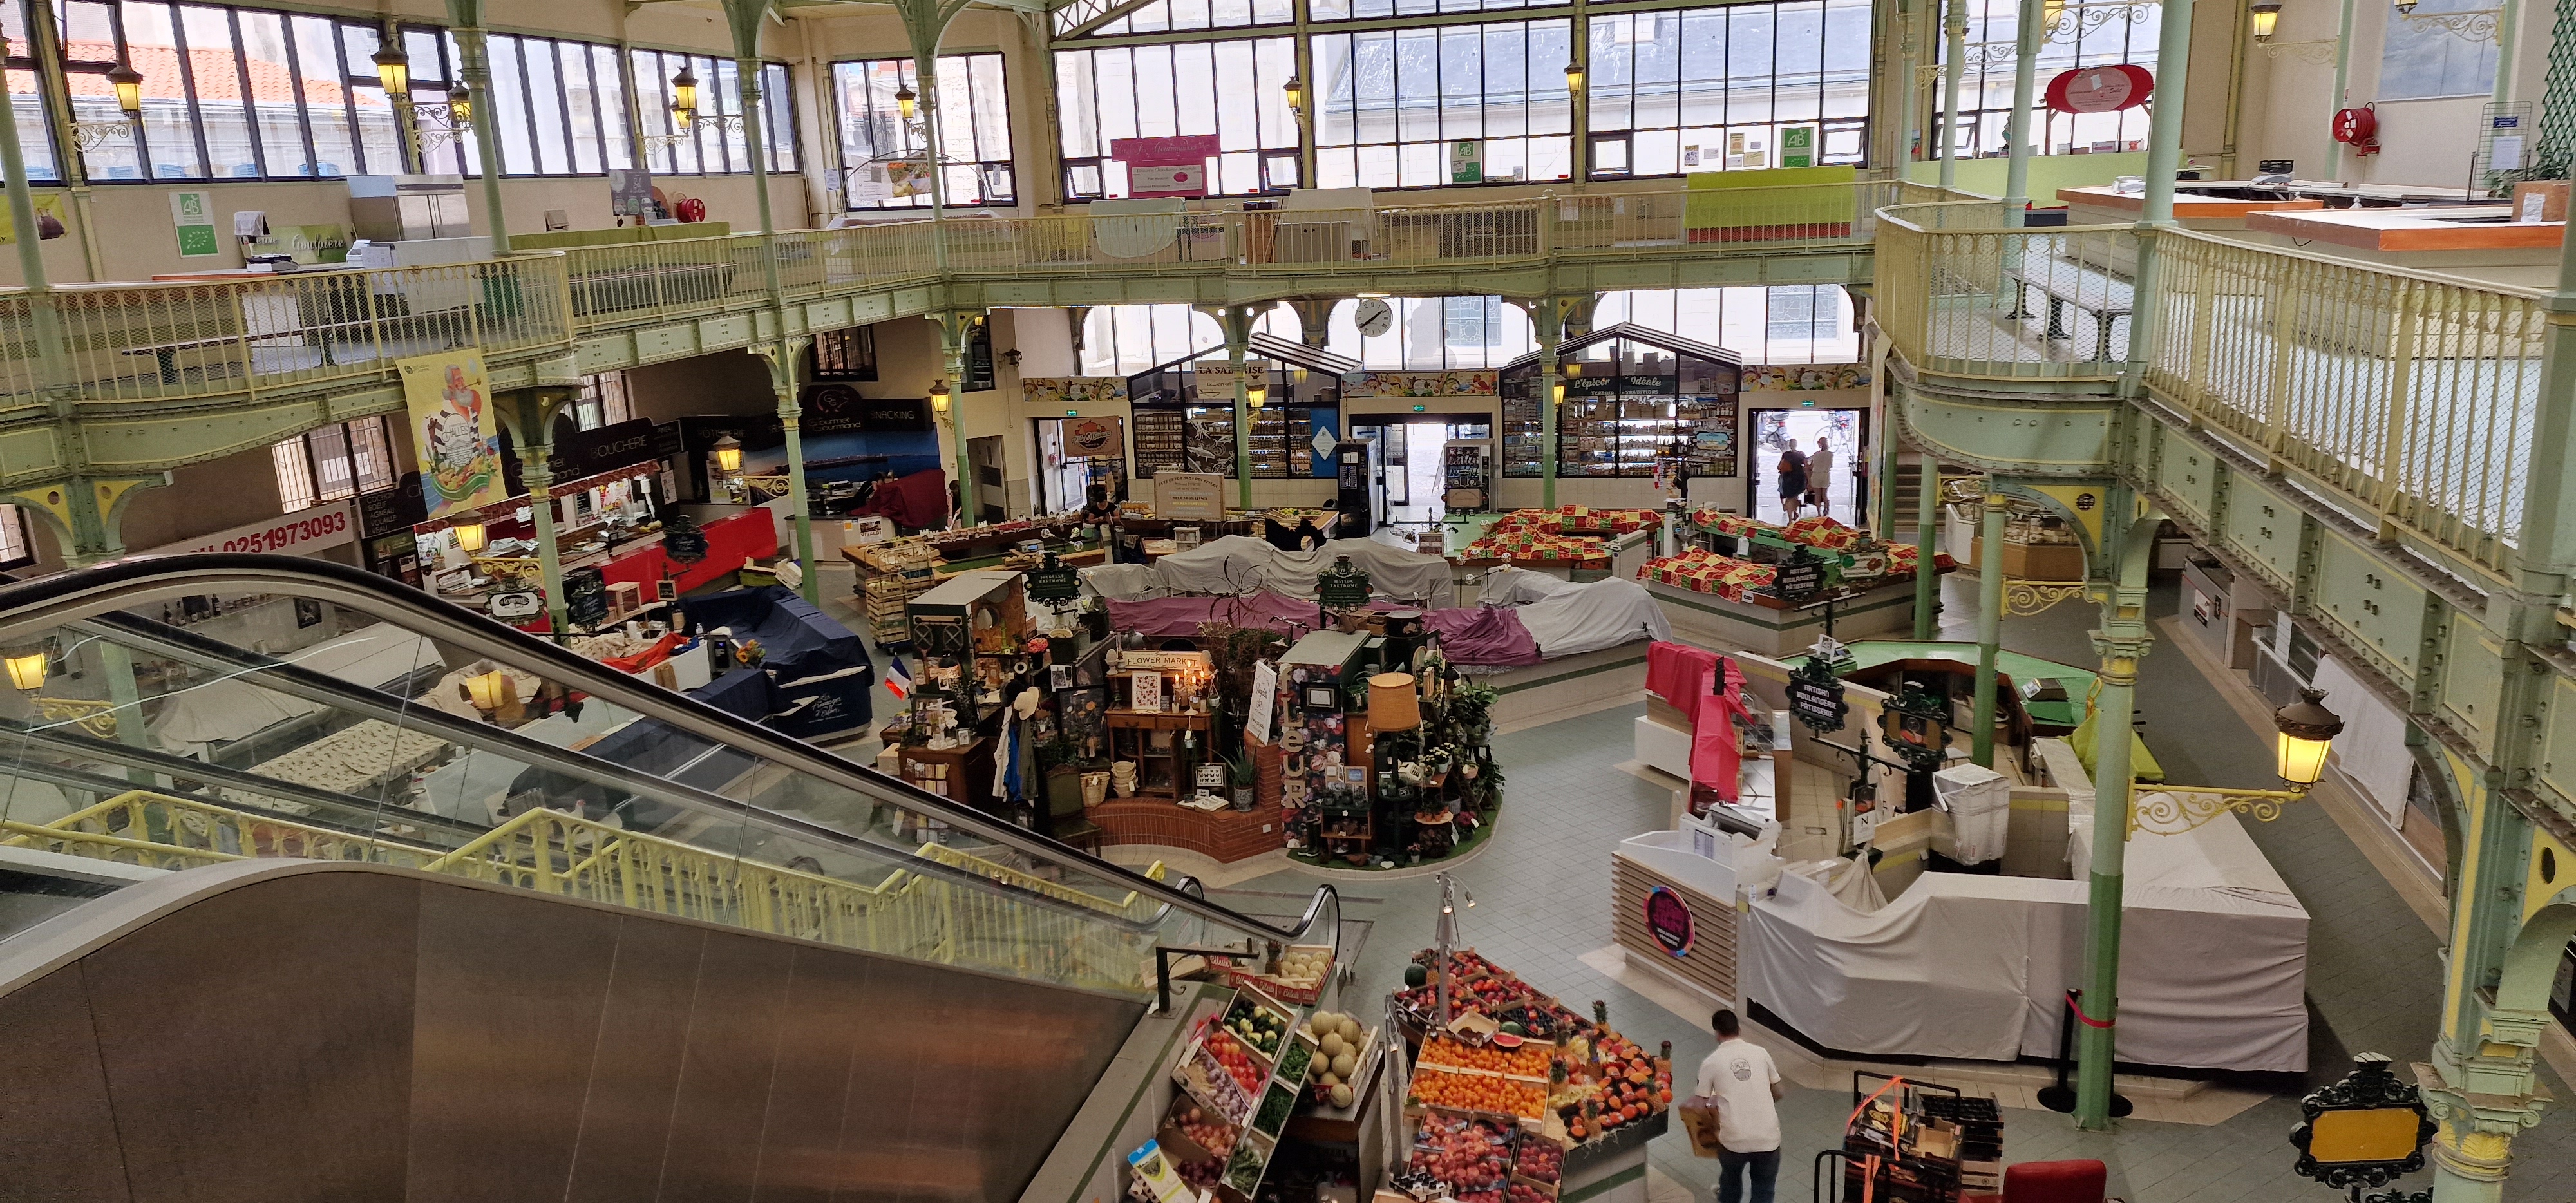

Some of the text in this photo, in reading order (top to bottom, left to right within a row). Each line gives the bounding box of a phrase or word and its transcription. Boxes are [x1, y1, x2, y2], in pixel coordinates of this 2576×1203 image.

[590, 435, 648, 459] BOUCHERIE
[223, 511, 346, 553] 0251973093
[1782, 573, 1818, 583] BOULANGERIE
[1789, 567, 1812, 575] ARTISAN
[1785, 582, 1815, 591] PÂTISSERIE
[1804, 684, 1830, 697] ARTISAN
[1796, 691, 1837, 709] BOULANGERIE
[1800, 701, 1833, 718] PÂTISSERIE
